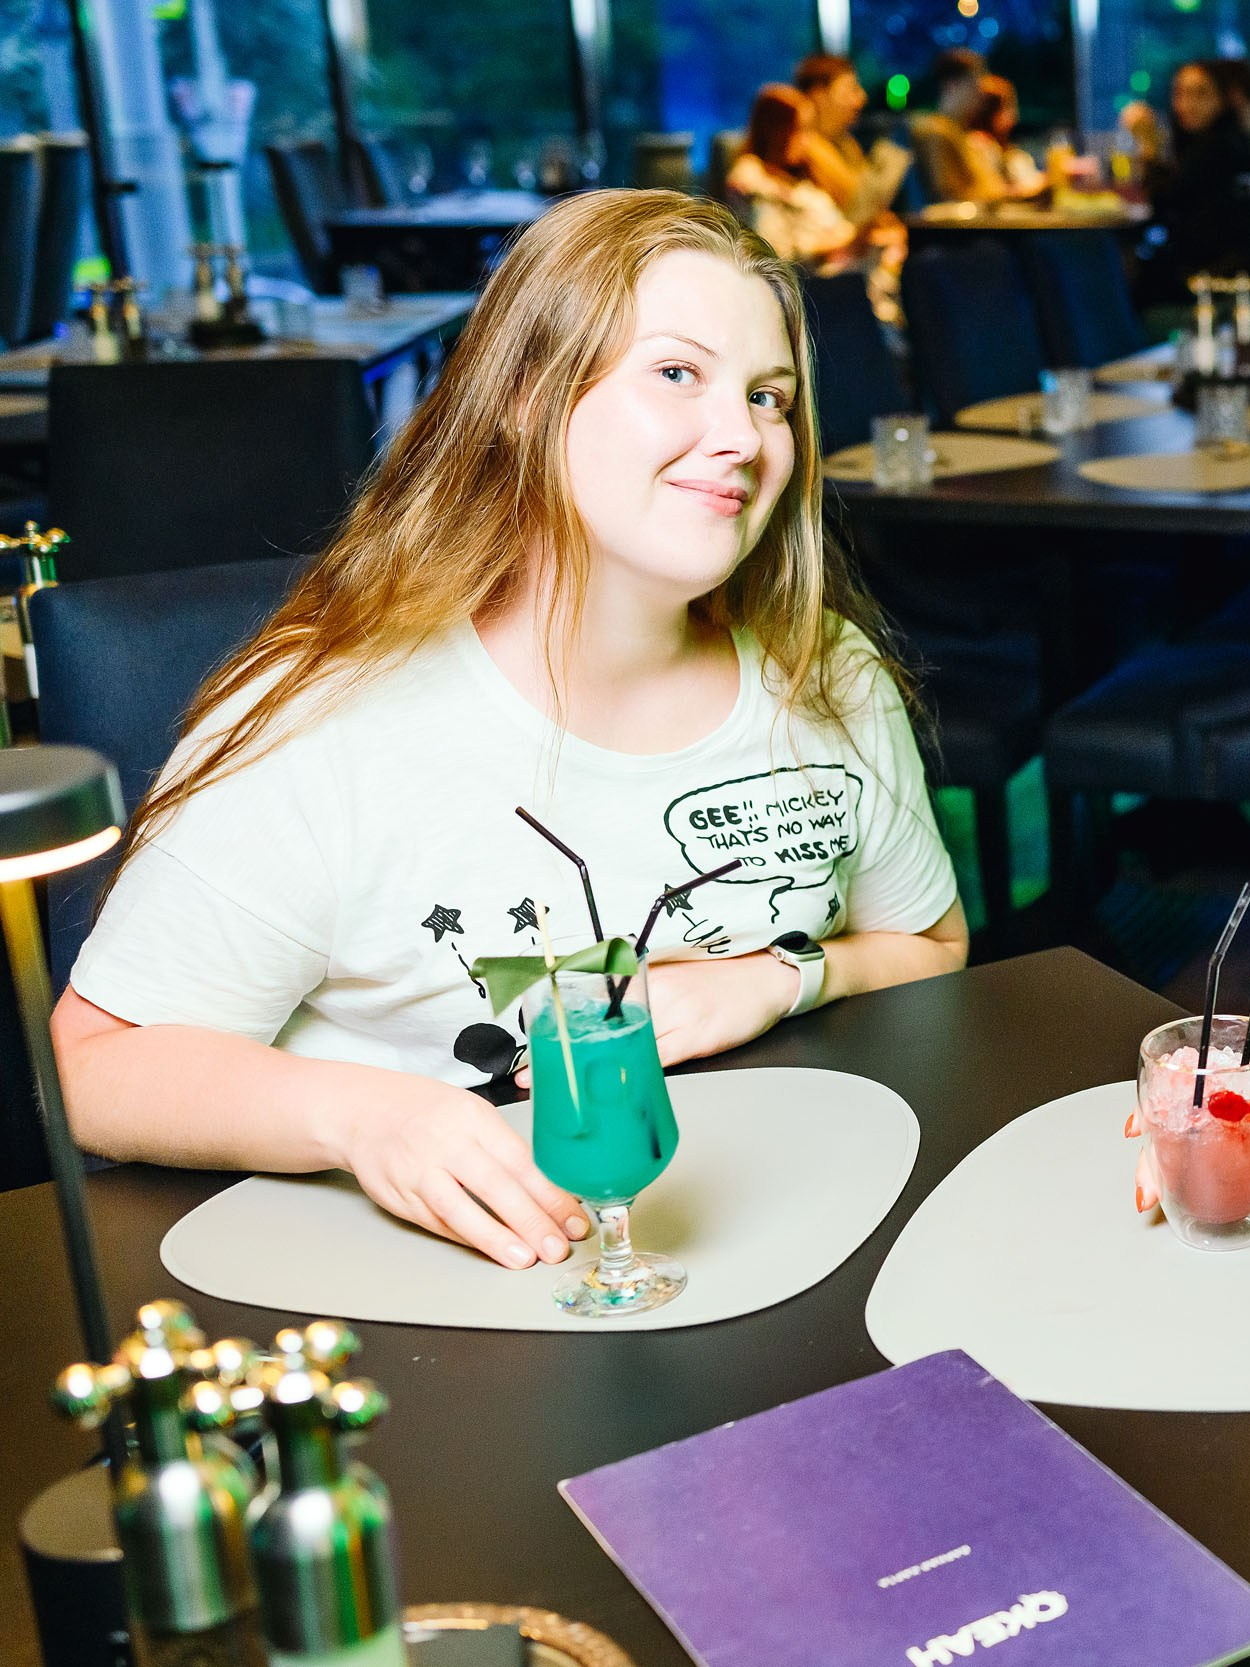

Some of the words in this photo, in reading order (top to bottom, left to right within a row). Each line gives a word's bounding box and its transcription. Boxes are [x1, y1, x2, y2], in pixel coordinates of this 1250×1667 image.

[766, 789, 845, 816] MICKEY
[778, 820, 803, 838] NO
[809, 811, 847, 830] WAY
[735, 856, 766, 866] TO
[775, 842, 829, 863] KISS
[830, 835, 849, 854] ME
